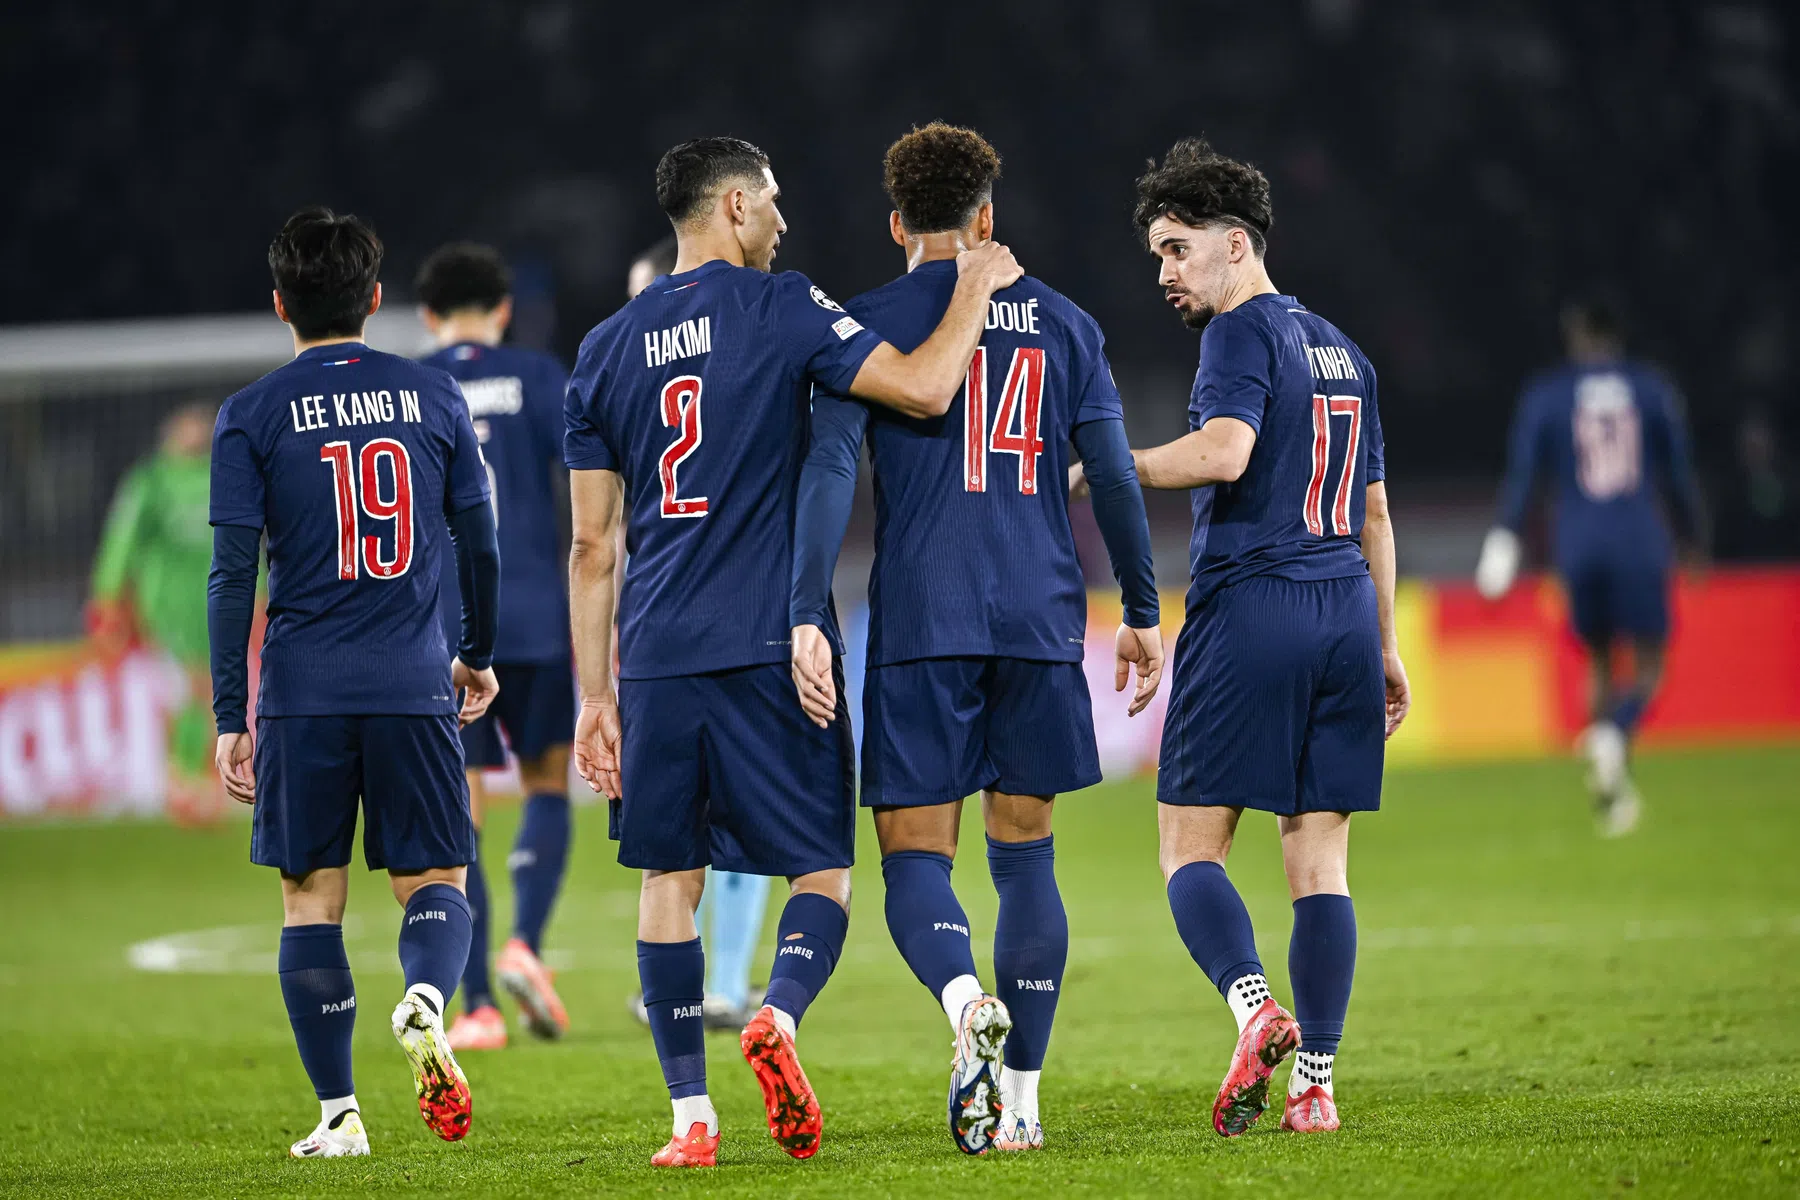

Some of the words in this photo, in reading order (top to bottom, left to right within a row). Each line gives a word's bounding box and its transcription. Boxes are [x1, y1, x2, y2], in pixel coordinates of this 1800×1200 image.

[985, 298, 1040, 335] DOUÉ
[644, 316, 712, 368] HAKIMI
[290, 395, 329, 433] LEE
[332, 390, 395, 427] KANG
[398, 389, 422, 423] IN
[964, 346, 1046, 495] 14
[659, 374, 709, 519] 2
[1303, 393, 1362, 537] 17
[320, 437, 414, 580] 19
[408, 910, 447, 926] PARIS
[933, 921, 969, 937] PARIS
[779, 945, 814, 960] PARIS
[1016, 979, 1055, 992] PARIS
[321, 995, 356, 1015] PARIS
[673, 1004, 703, 1020] PARIS
